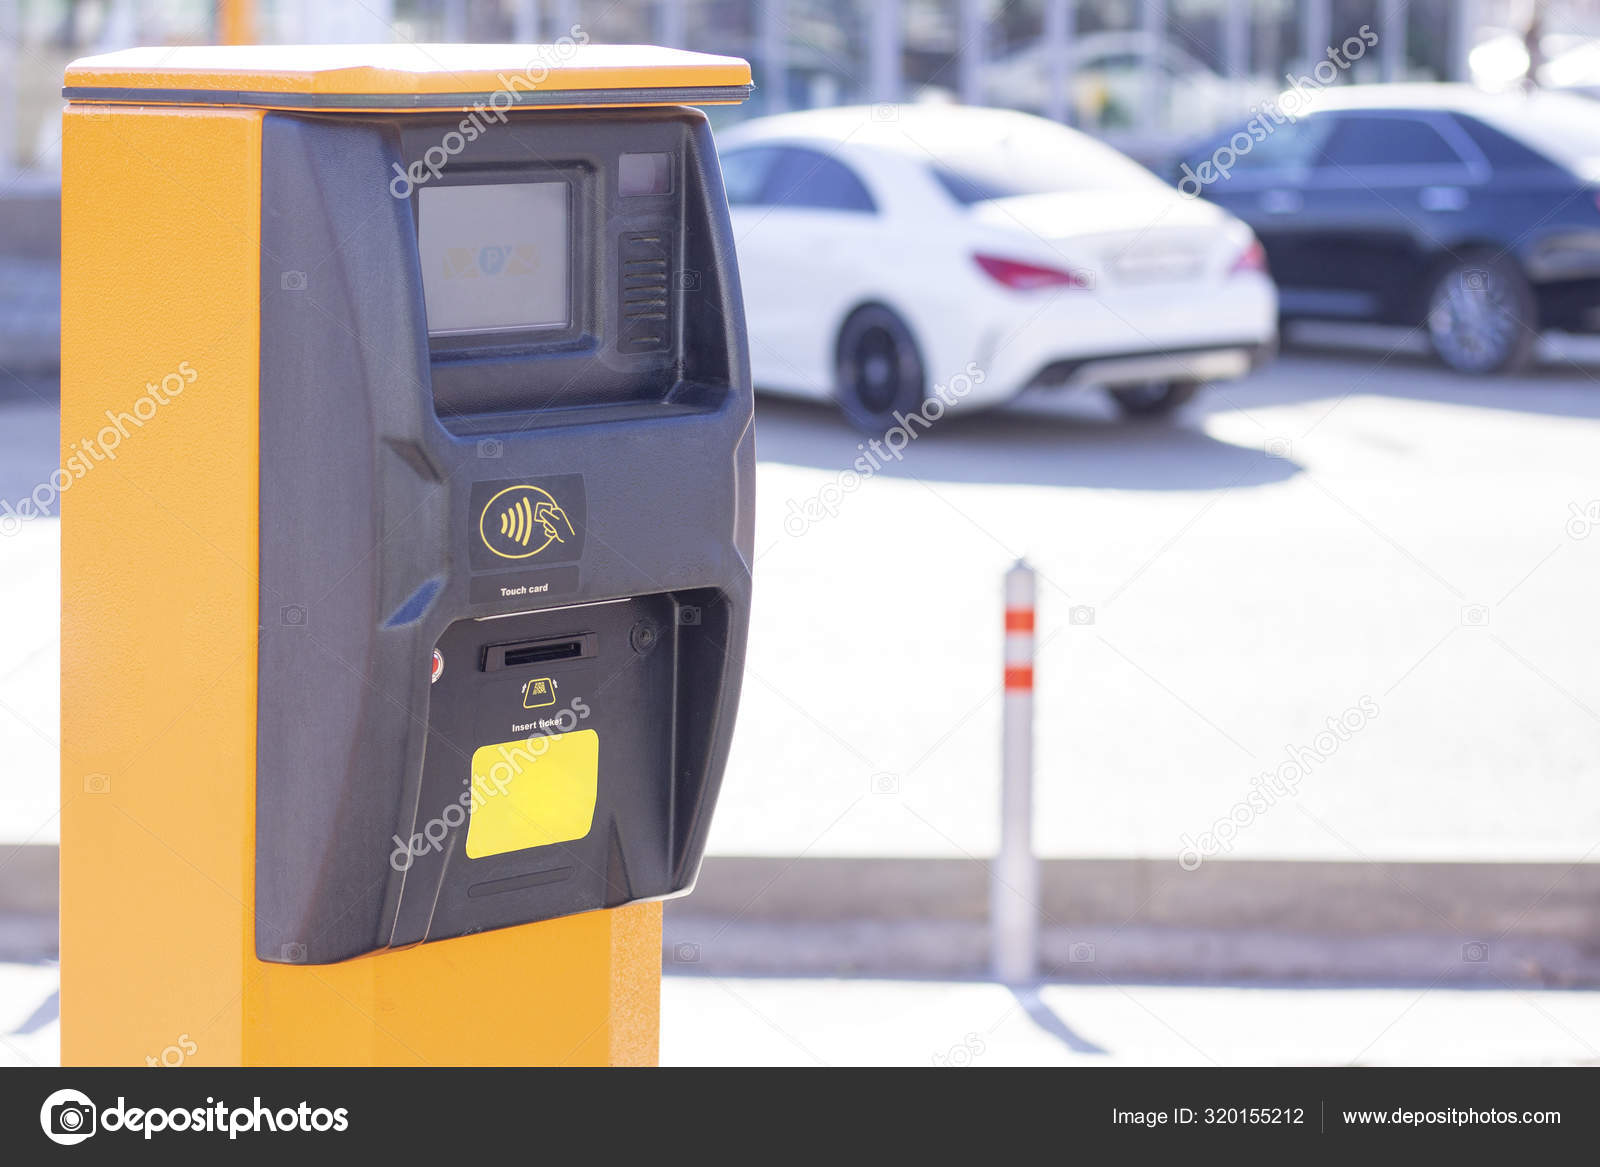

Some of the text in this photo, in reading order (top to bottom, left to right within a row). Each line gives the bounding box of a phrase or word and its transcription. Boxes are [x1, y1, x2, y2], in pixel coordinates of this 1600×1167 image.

[500, 583, 549, 597] Touch card
[512, 717, 563, 732] Insert ticket
